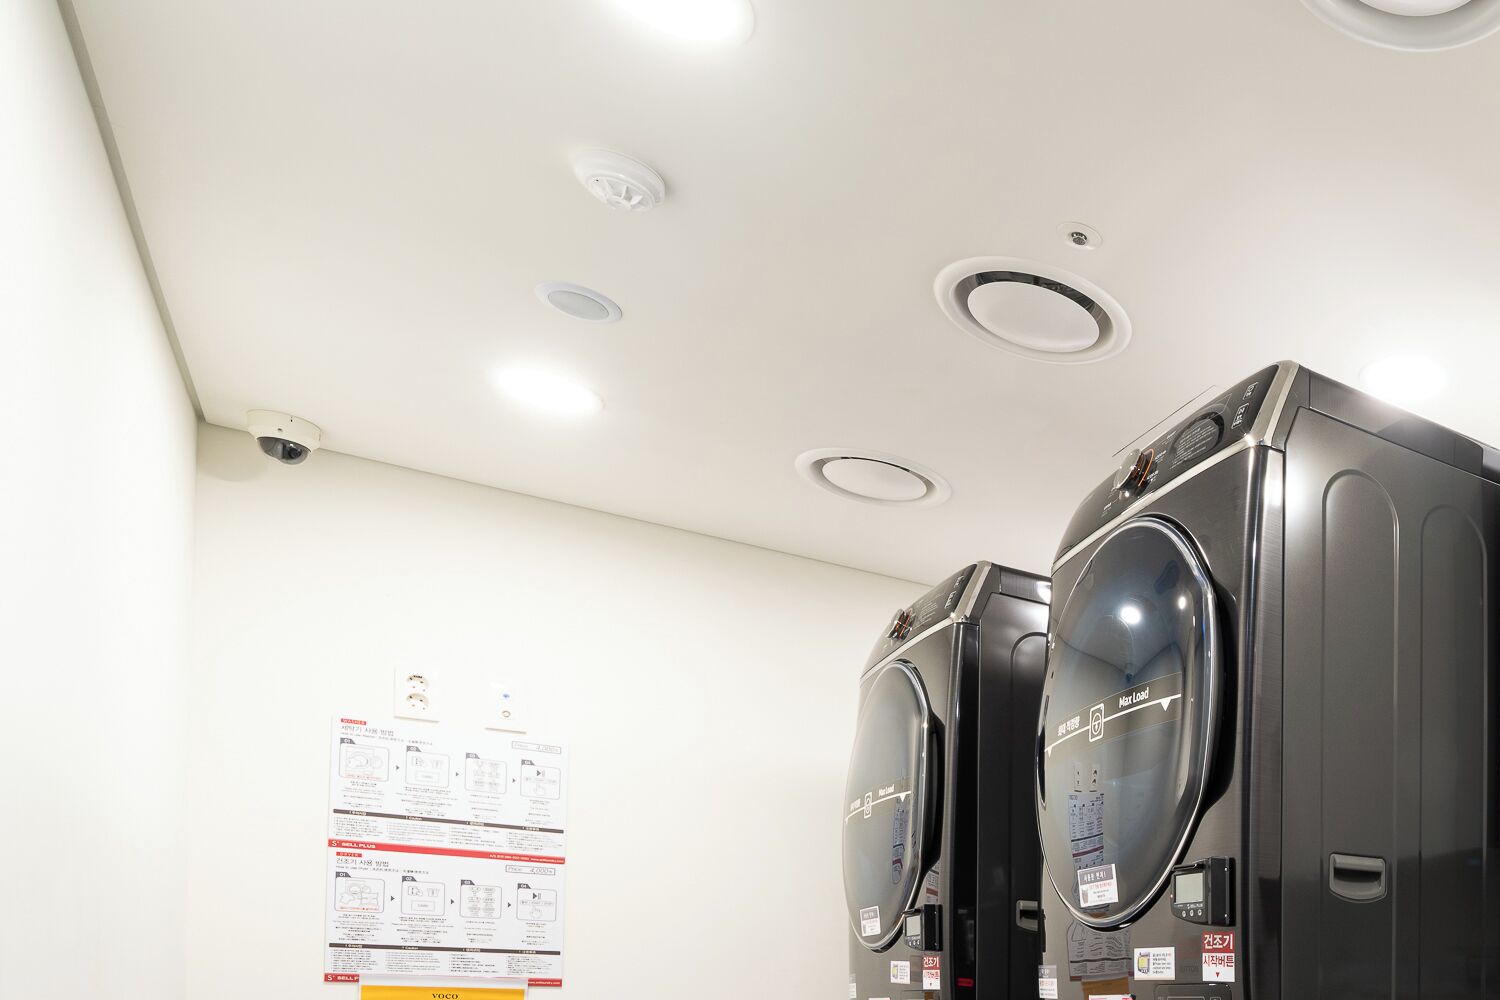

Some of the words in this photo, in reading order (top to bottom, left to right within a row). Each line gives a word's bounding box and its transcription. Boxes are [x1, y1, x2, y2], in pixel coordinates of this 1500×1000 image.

[1119, 695, 1132, 708] Max
[1133, 687, 1149, 702] Load
[1204, 934, 1233, 949] 건조기
[1203, 955, 1234, 967] 시작버튼
